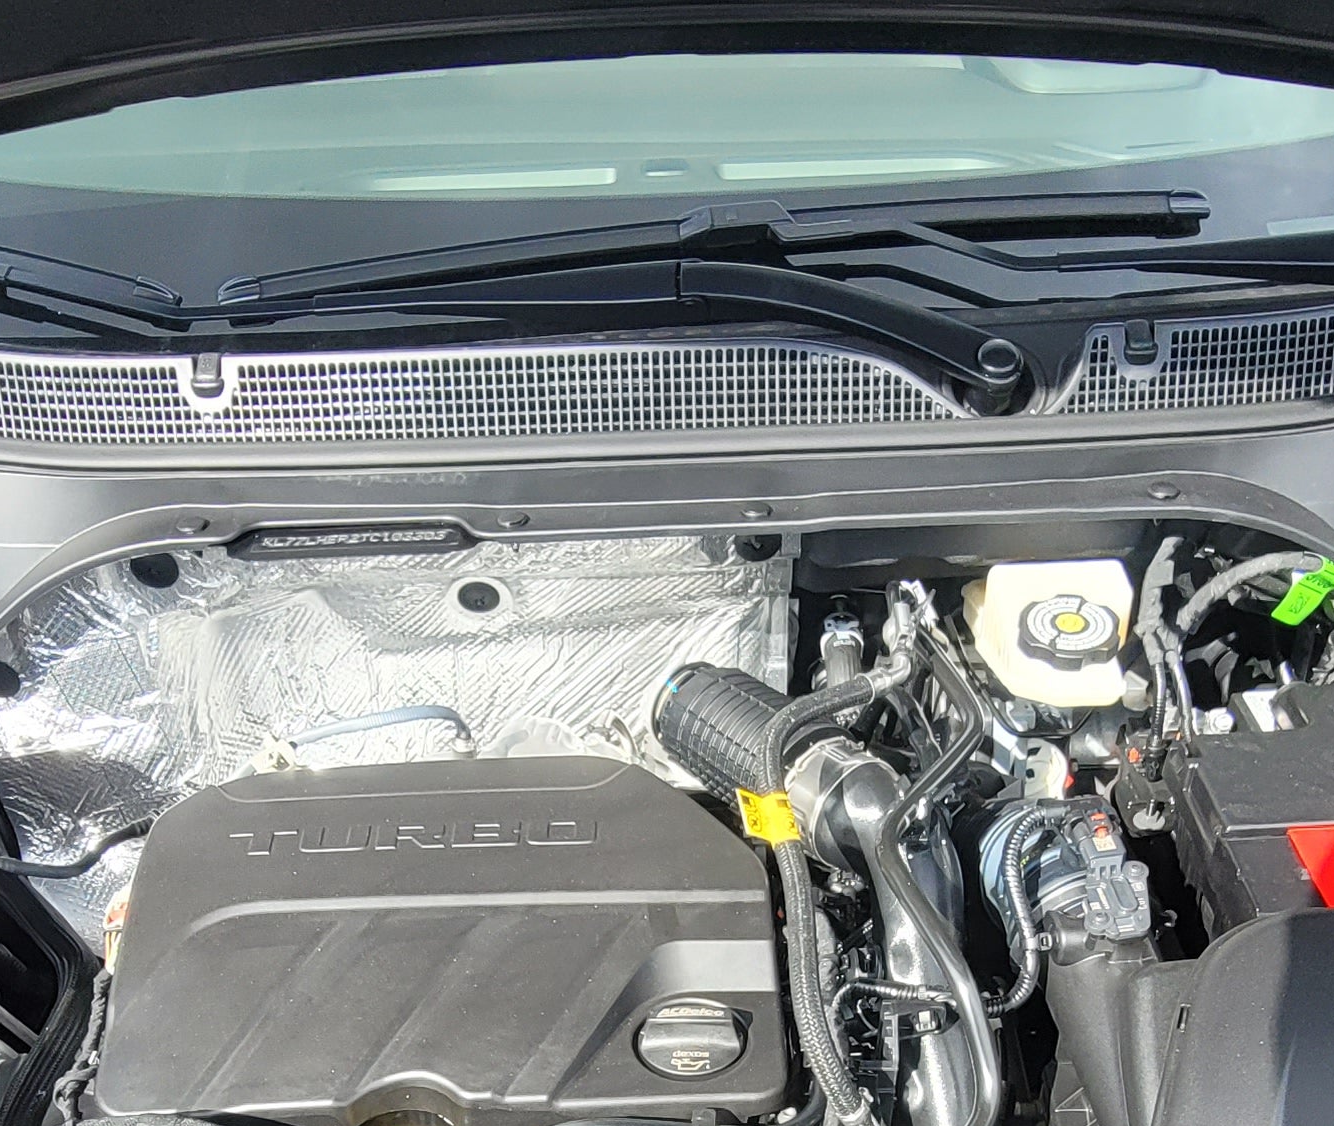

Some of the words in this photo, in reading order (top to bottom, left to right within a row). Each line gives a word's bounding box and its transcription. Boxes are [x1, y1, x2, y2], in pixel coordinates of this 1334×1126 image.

[228, 820, 599, 856] TURBO
[656, 1007, 726, 1018] ACDelco
[672, 1050, 710, 1058] dexos
